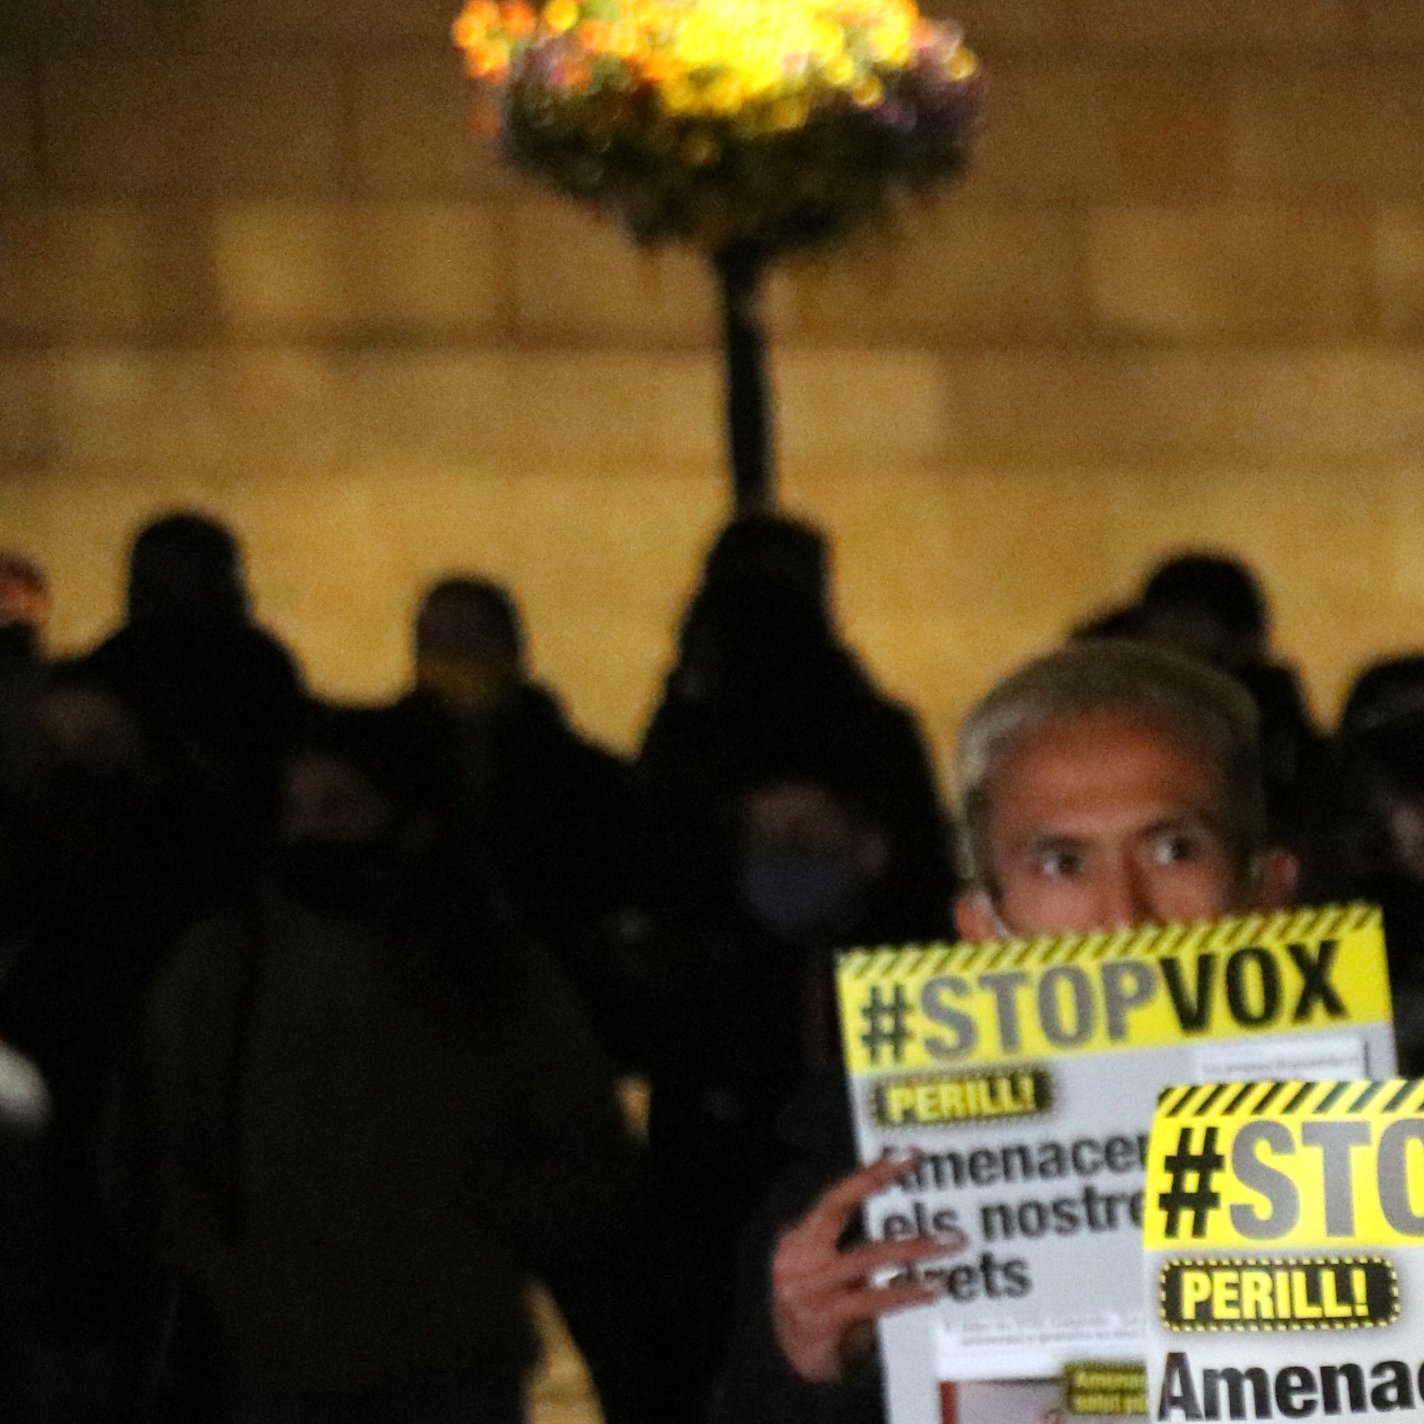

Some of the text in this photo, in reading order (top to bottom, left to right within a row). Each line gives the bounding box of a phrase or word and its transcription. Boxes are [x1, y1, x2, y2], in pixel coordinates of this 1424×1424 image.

[860, 939, 1351, 1064] #STOPVOX
[887, 1073, 1035, 1122] PERILL!
[1181, 1270, 1368, 1322] PERILL!
